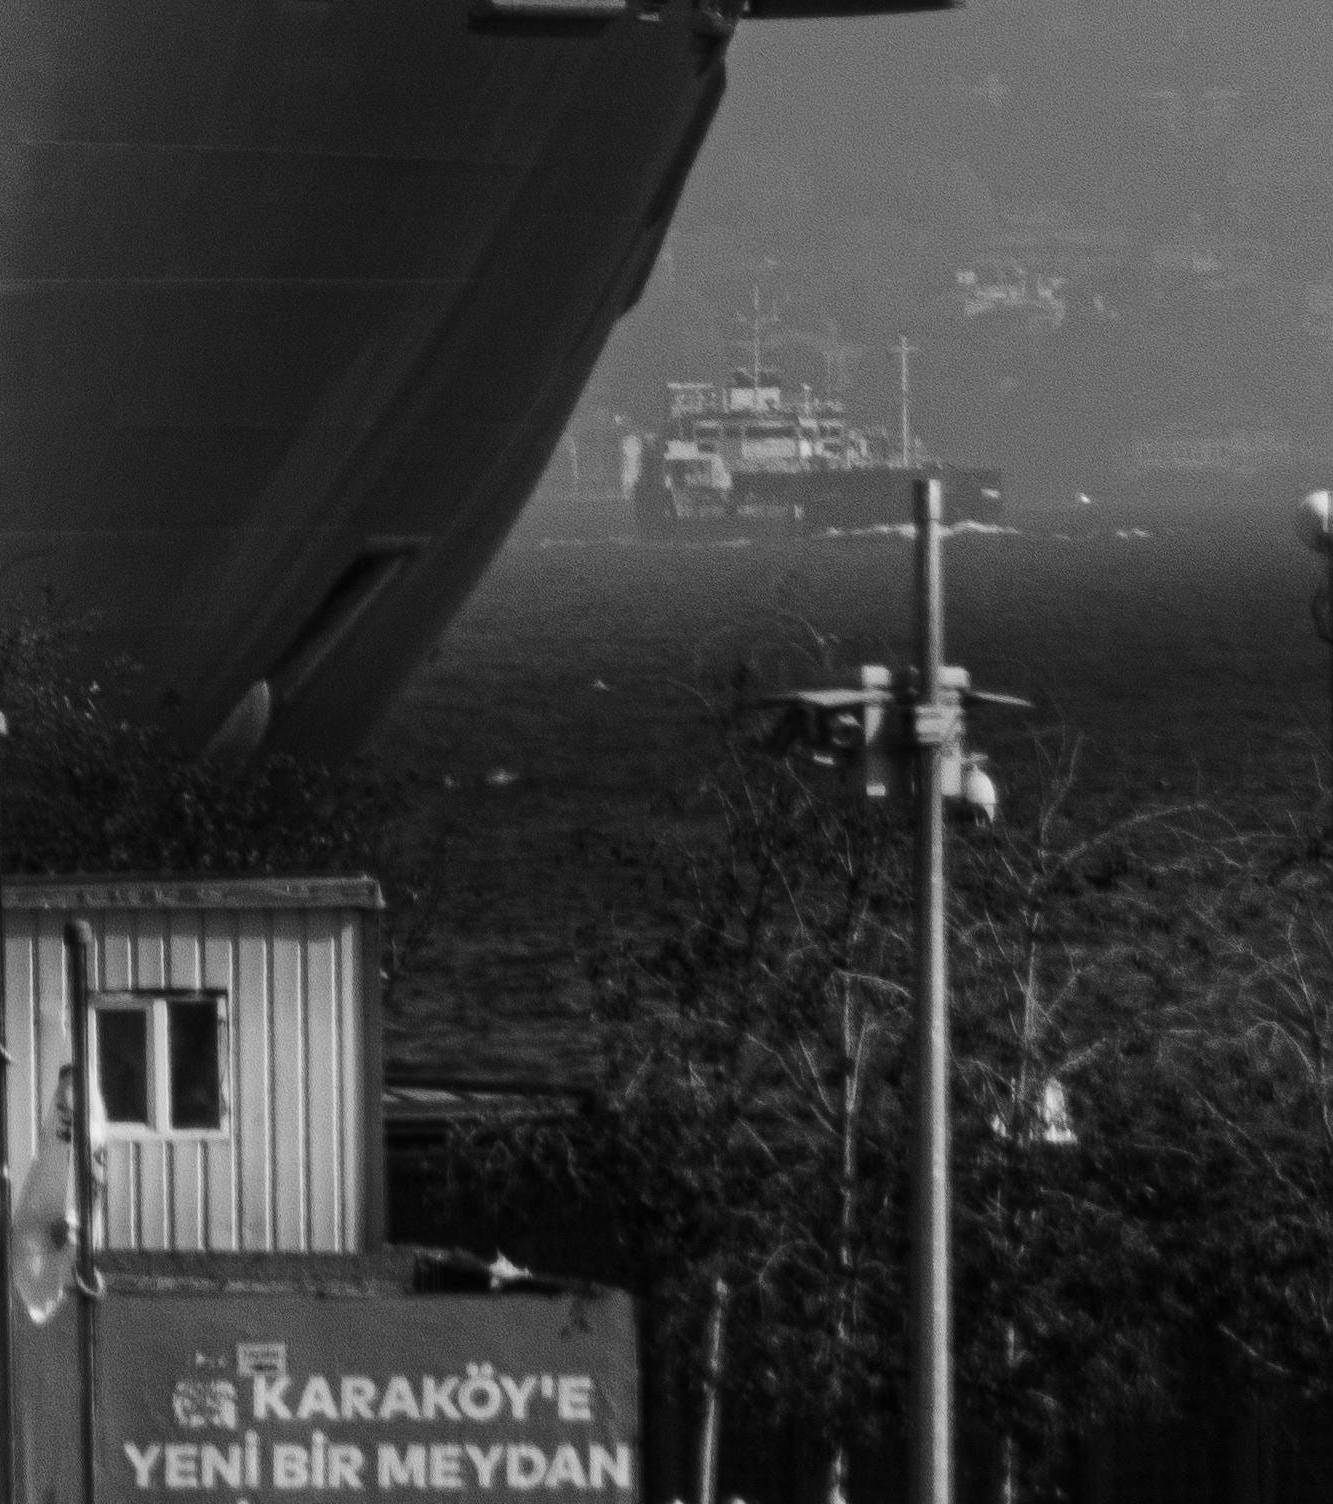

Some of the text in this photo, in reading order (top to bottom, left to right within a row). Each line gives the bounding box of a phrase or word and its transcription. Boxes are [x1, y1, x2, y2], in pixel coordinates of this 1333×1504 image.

[252, 1362, 593, 1422] KARAKÖY'E
[124, 1431, 631, 1489] YENİ BİR MEYDAN
